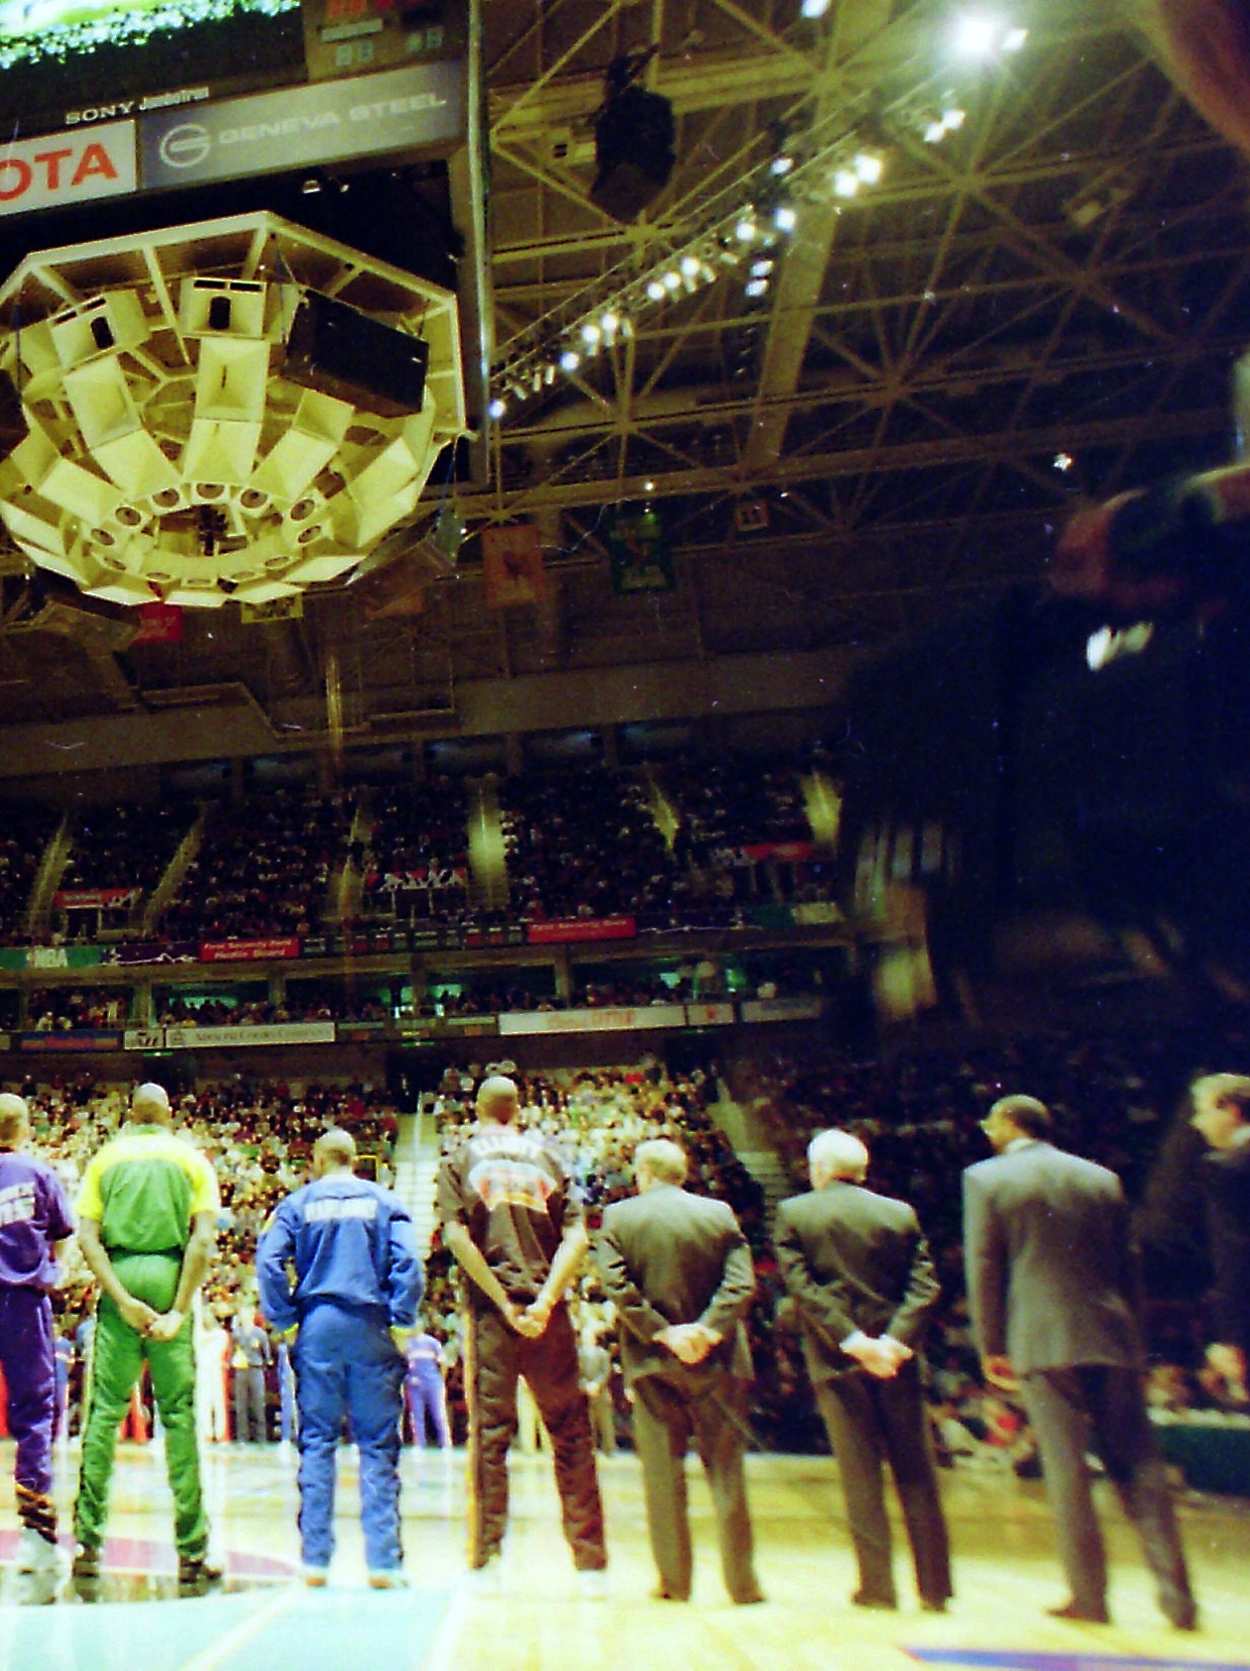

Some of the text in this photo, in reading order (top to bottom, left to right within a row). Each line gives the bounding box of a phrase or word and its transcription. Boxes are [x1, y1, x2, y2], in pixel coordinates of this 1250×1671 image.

[65, 101, 135, 125] SONY
[218, 92, 448, 144] GENEVA STEEL
